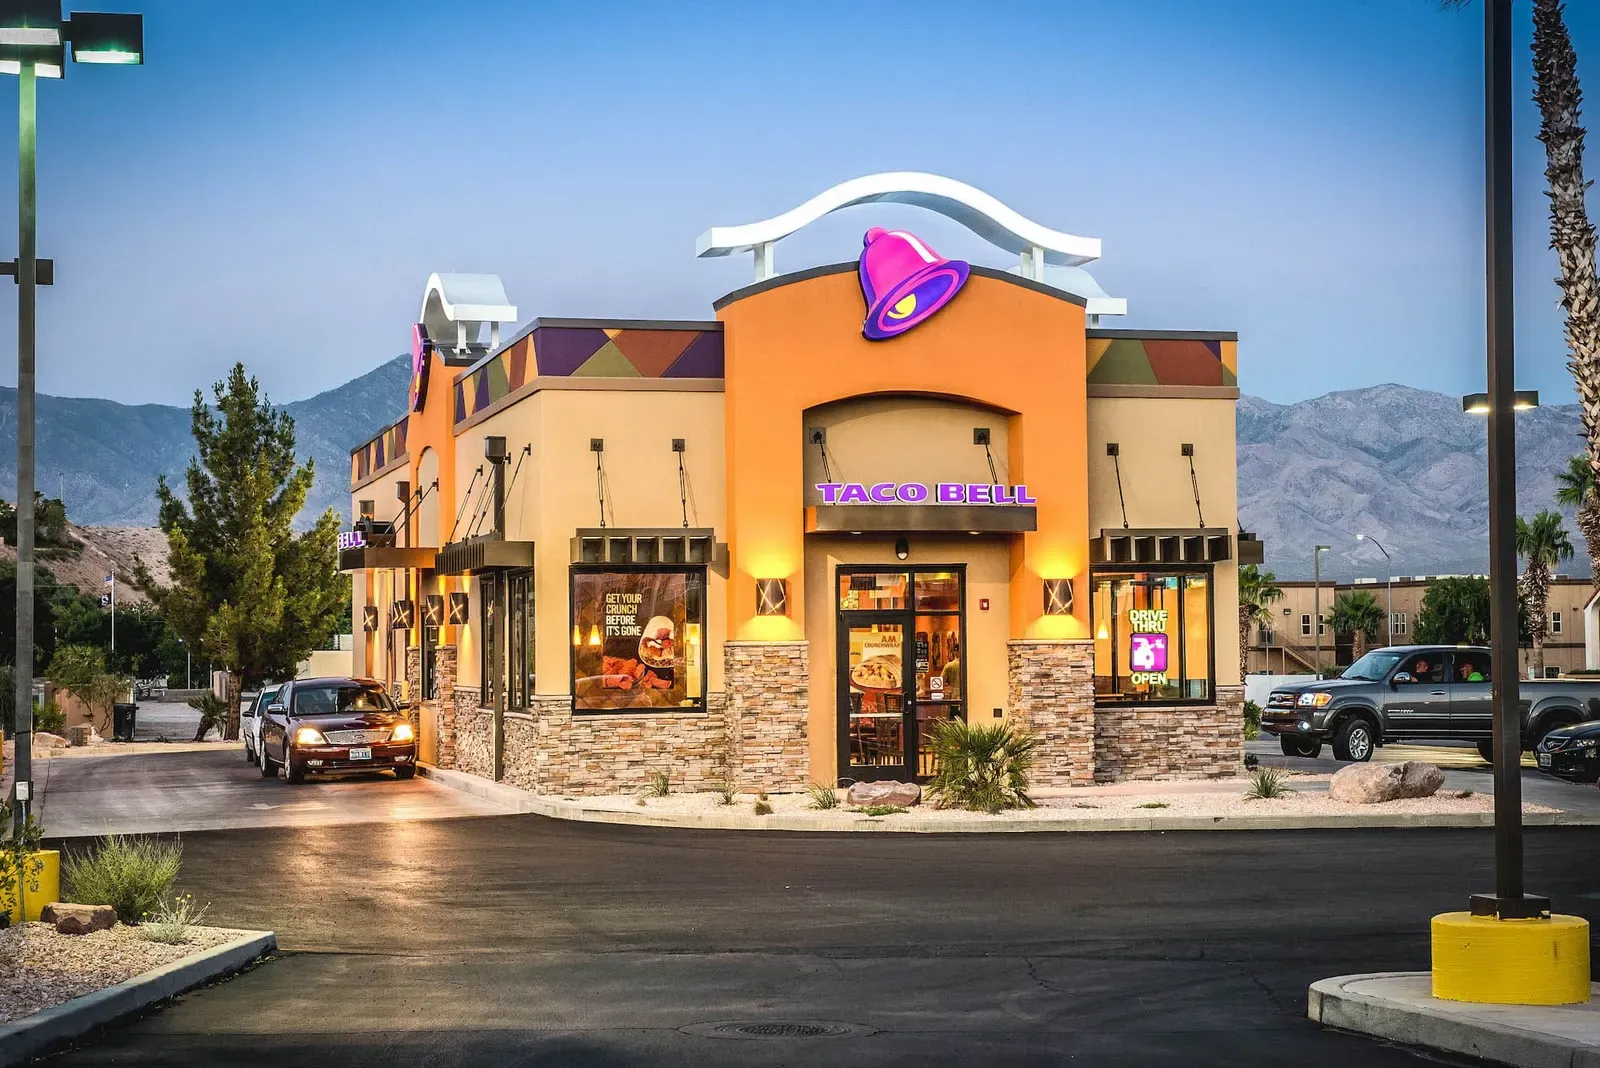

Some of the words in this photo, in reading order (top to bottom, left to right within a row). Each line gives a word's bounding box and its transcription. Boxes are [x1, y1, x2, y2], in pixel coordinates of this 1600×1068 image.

[815, 482, 928, 504] TACO
[937, 484, 1037, 504] BELL
[606, 593, 620, 604] GET
[621, 593, 642, 604] YOUR
[606, 604, 637, 614] CRUNCH
[606, 615, 636, 625] BEFORE
[1129, 609, 1168, 621] DRIVE
[606, 626, 620, 636] IT'S
[621, 626, 642, 636] GONE
[1132, 621, 1166, 632] THRU
[1131, 673, 1168, 685] OPEN
